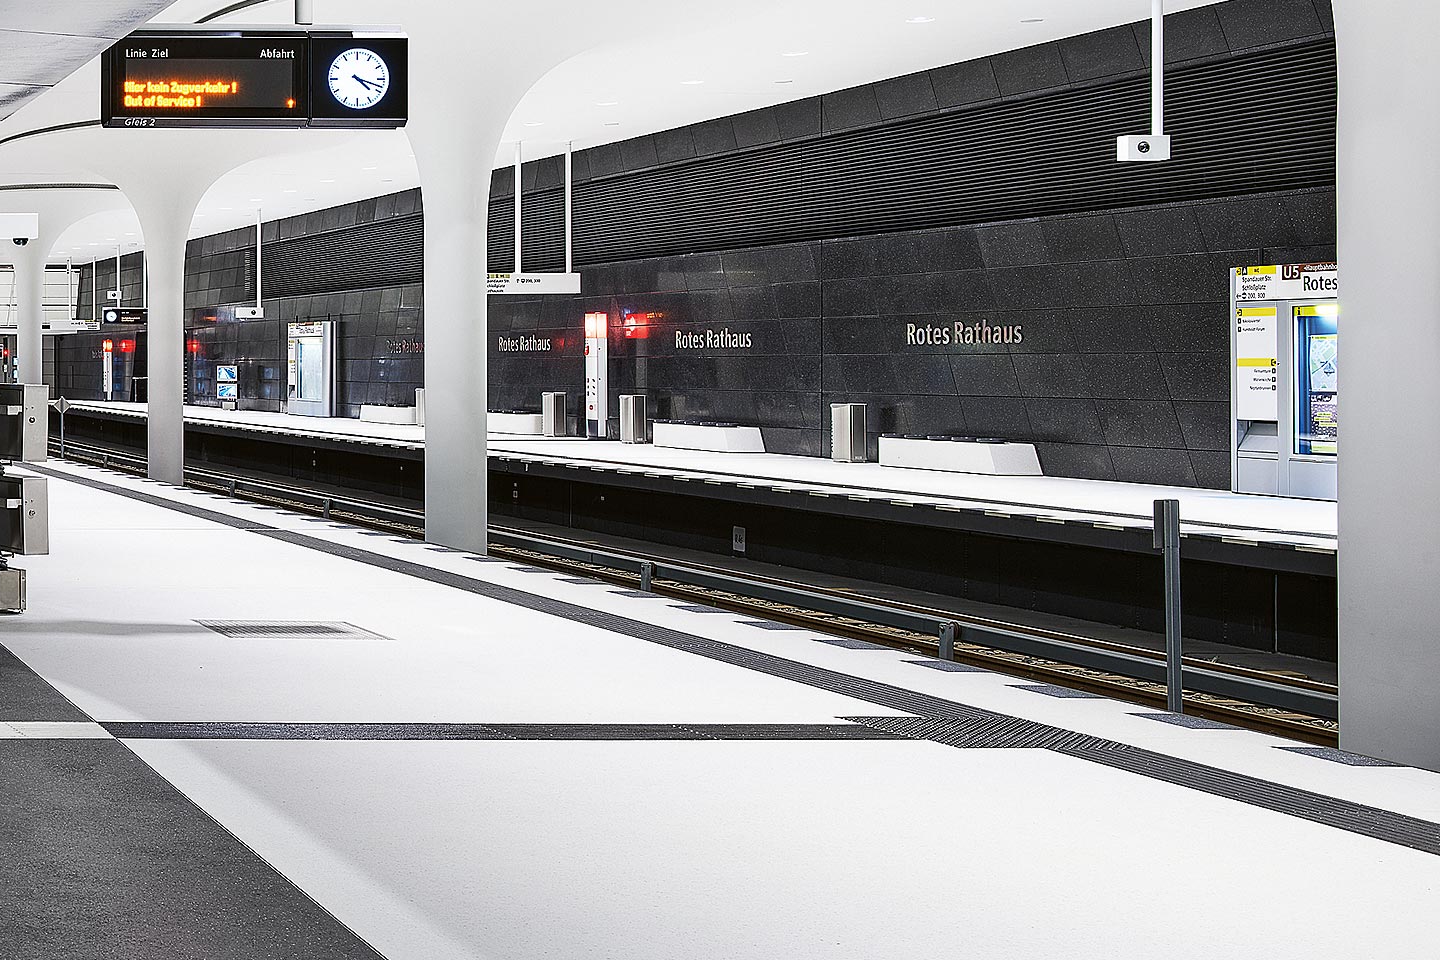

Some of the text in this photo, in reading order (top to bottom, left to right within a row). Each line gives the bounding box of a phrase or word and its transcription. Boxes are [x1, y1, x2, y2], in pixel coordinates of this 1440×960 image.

[125, 48, 169, 58] Linie Ziel
[260, 48, 295, 59] Abfahrt
[124, 81, 146, 93] Hier
[147, 81, 169, 93] kein
[170, 81, 230, 95] Zugverkehr
[124, 95, 143, 107] Out
[144, 95, 156, 107] of
[156, 95, 195, 107] Service
[124, 118, 156, 127] Gleis 2
[1283, 265, 1300, 279] U5
[1305, 263, 1337, 272] Hauptbahnho
[1303, 275, 1337, 292] Rotes
[675, 327, 752, 349] Rotes Rathaus
[907, 319, 1022, 346] Rotes Rathaus
[498, 334, 551, 352] Rotes Rathaus
